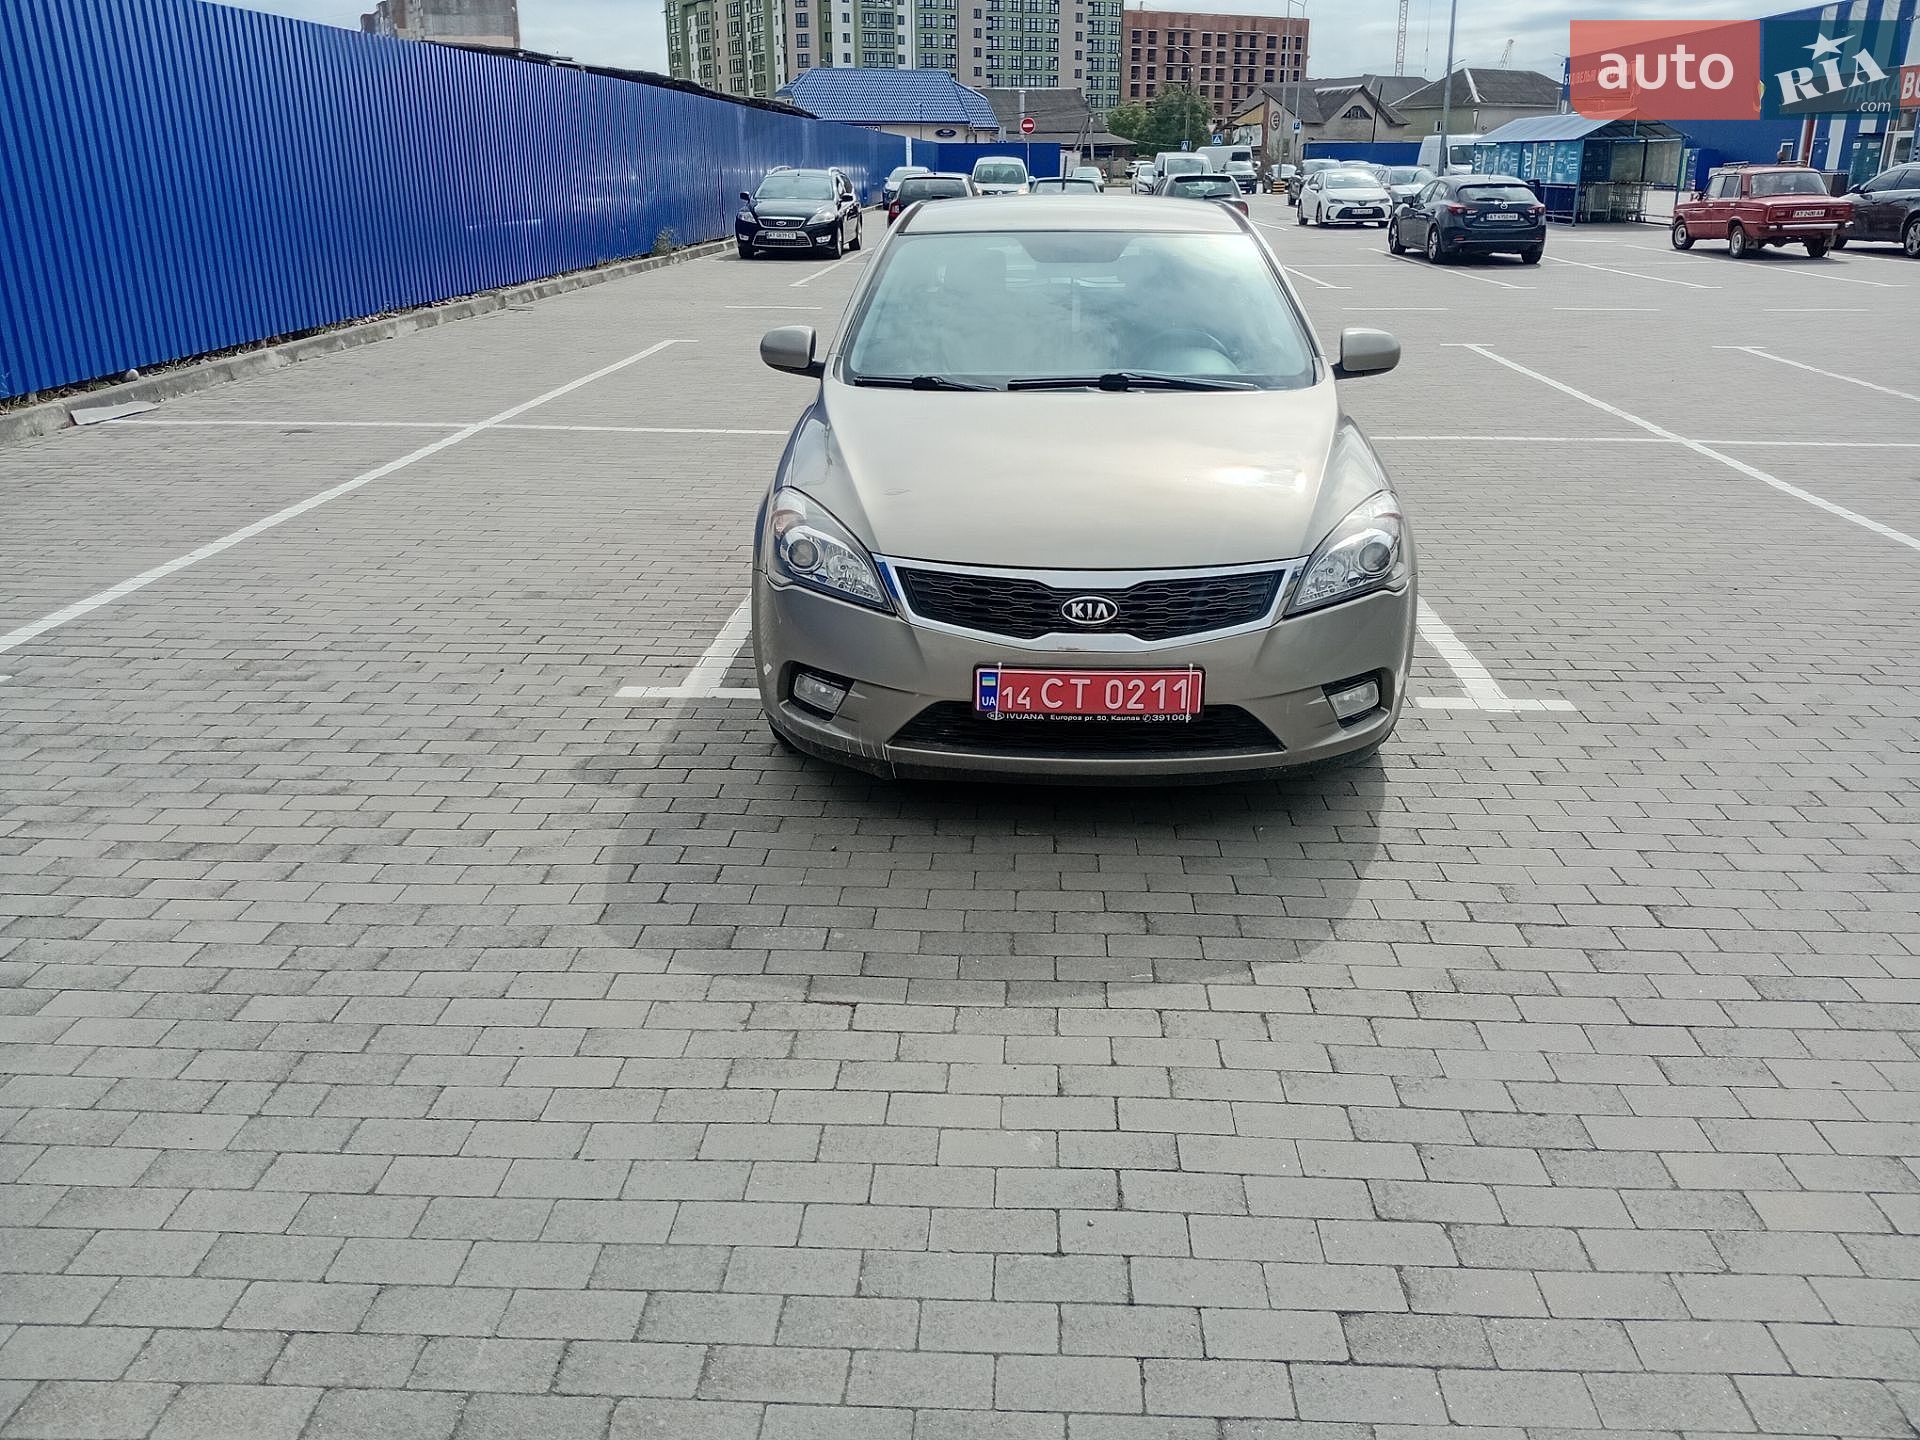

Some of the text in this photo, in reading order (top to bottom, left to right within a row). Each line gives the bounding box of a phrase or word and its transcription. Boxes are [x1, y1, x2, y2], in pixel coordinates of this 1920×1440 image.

[1071, 602, 1109, 620] KIA
[982, 696, 996, 706] UA
[1001, 678, 1188, 709] 14 CT 0211
